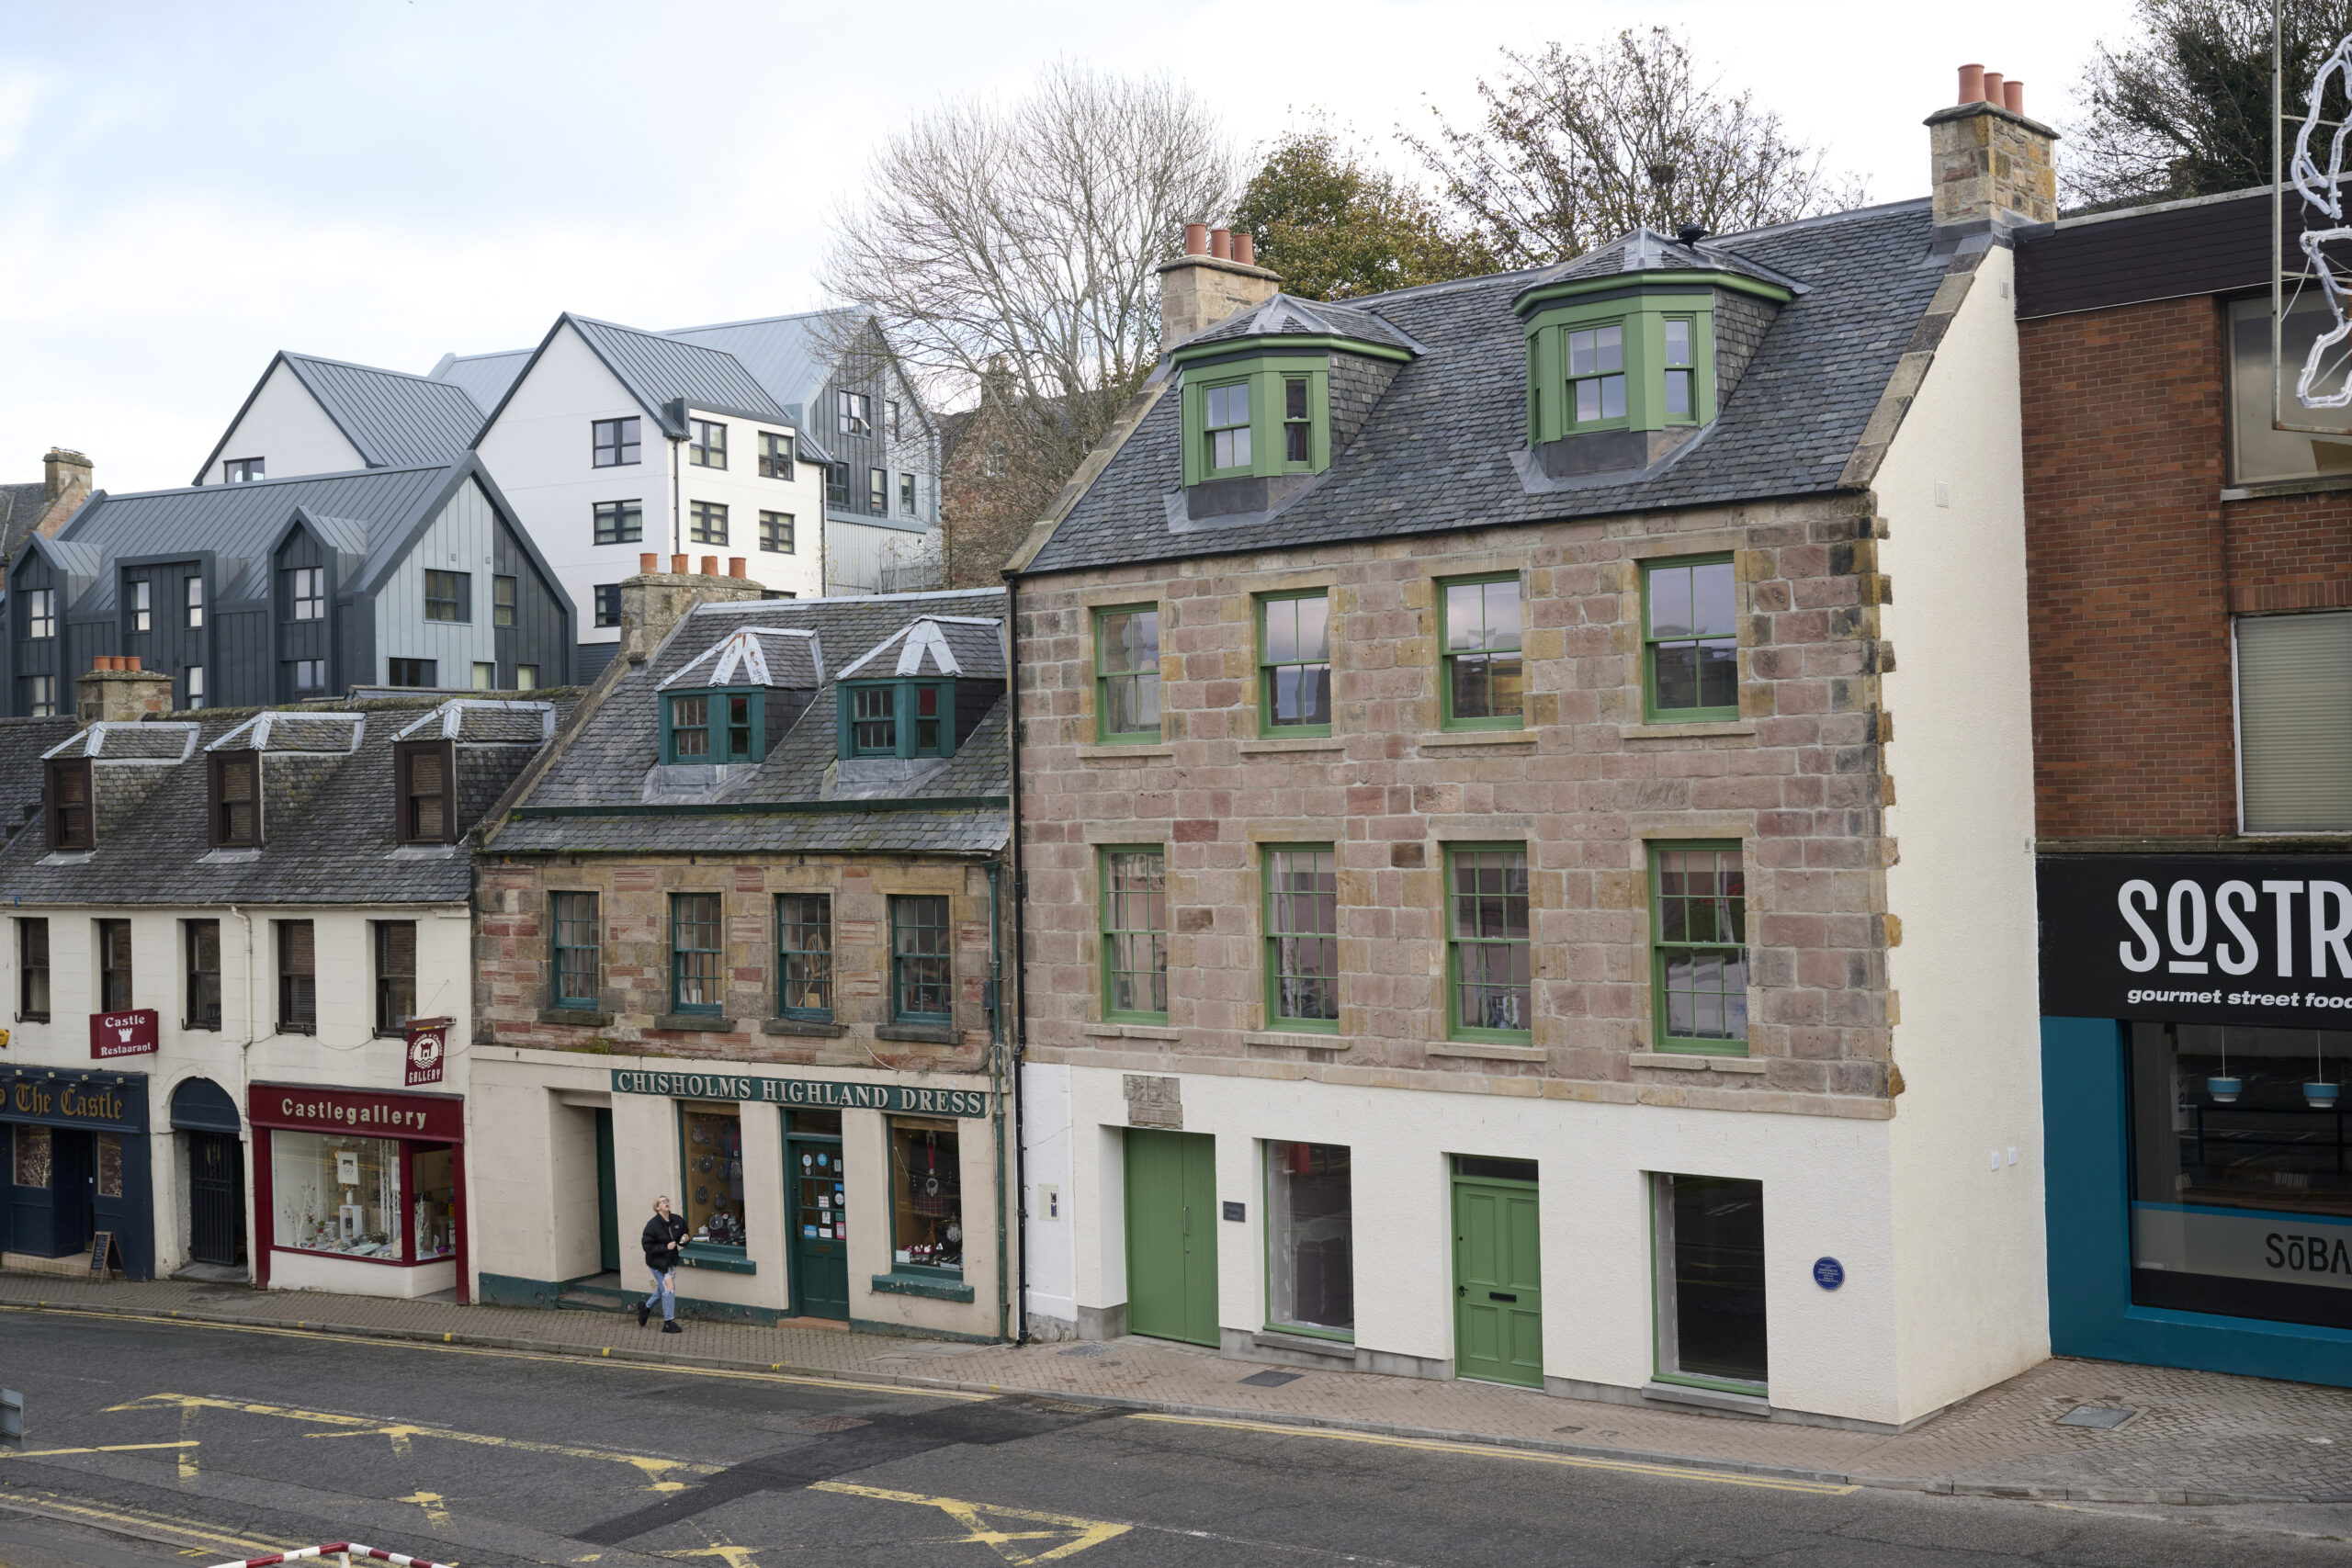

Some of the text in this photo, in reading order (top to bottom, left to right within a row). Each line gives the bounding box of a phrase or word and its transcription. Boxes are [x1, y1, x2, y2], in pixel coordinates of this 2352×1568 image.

[2127, 989, 2222, 1004] gourmet
[2227, 991, 2300, 1006] street
[105, 1014, 146, 1028] Castle
[100, 1042, 152, 1056] Restaurant
[409, 1068, 441, 1083] GALLERY
[15, 1083, 123, 1120] The Castle
[617, 1072, 982, 1114] CHISHOLMS HIGHLAND DRESS
[281, 1098, 426, 1130] Castlegallery
